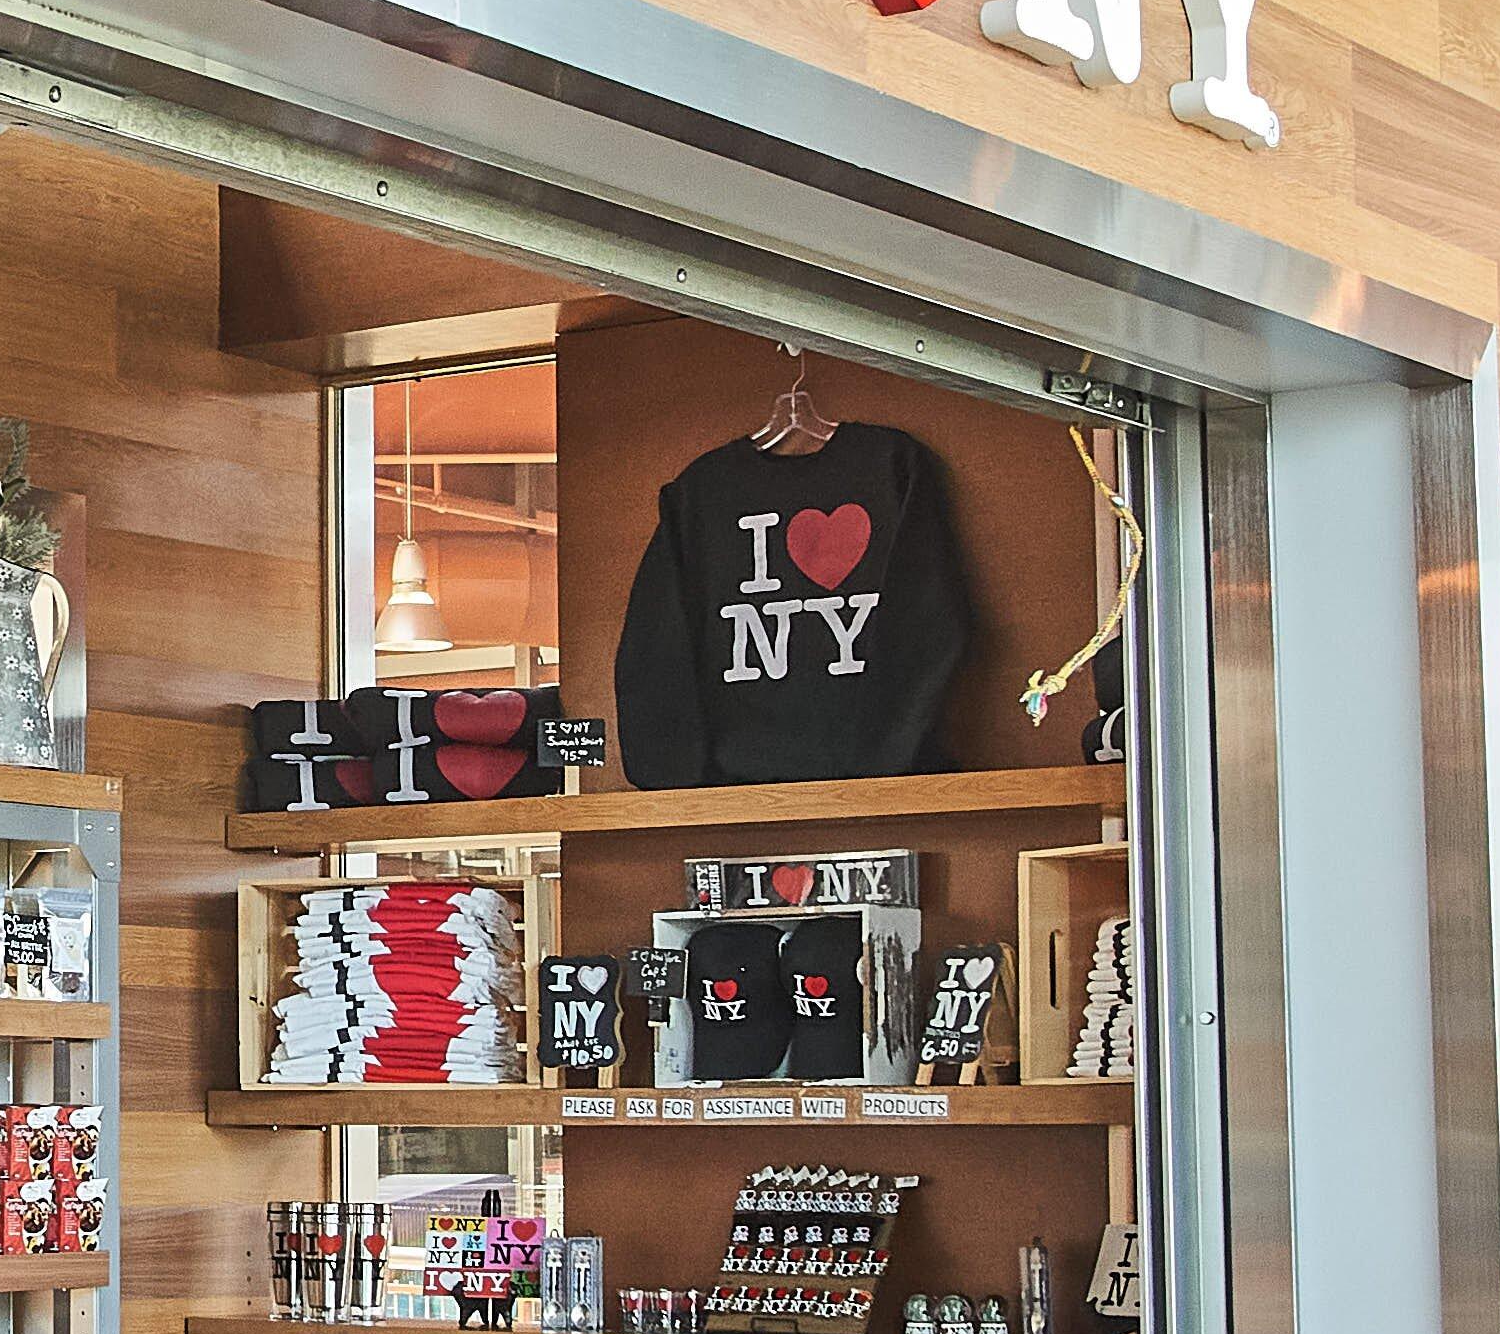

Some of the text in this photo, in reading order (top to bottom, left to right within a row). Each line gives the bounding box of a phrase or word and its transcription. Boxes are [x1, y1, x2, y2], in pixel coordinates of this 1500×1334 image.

[738, 512, 781, 594] I
[721, 592, 880, 683] NY
[573, 722, 590, 733] NY
[711, 864, 722, 910] STICKERS
[745, 861, 891, 905] I NY
[548, 966, 575, 992] I
[640, 965, 668, 978] Caps
[939, 958, 965, 989] I
[703, 980, 714, 1001] I
[795, 974, 806, 995] I
[703, 1000, 747, 1021] NY
[793, 995, 836, 1017] NY
[930, 990, 991, 1033] NY
[553, 1001, 604, 1038] NY
[564, 1097, 947, 1116] PLEASE ASK FOR ASSISTANCE WITH PRODUCTS
[430, 1218, 485, 1231] I NY
[499, 1220, 510, 1242] I
[433, 1236, 440, 1248] I
[428, 1250, 459, 1264] NY
[490, 1243, 540, 1265] NY
[426, 1271, 511, 1292] I NY
